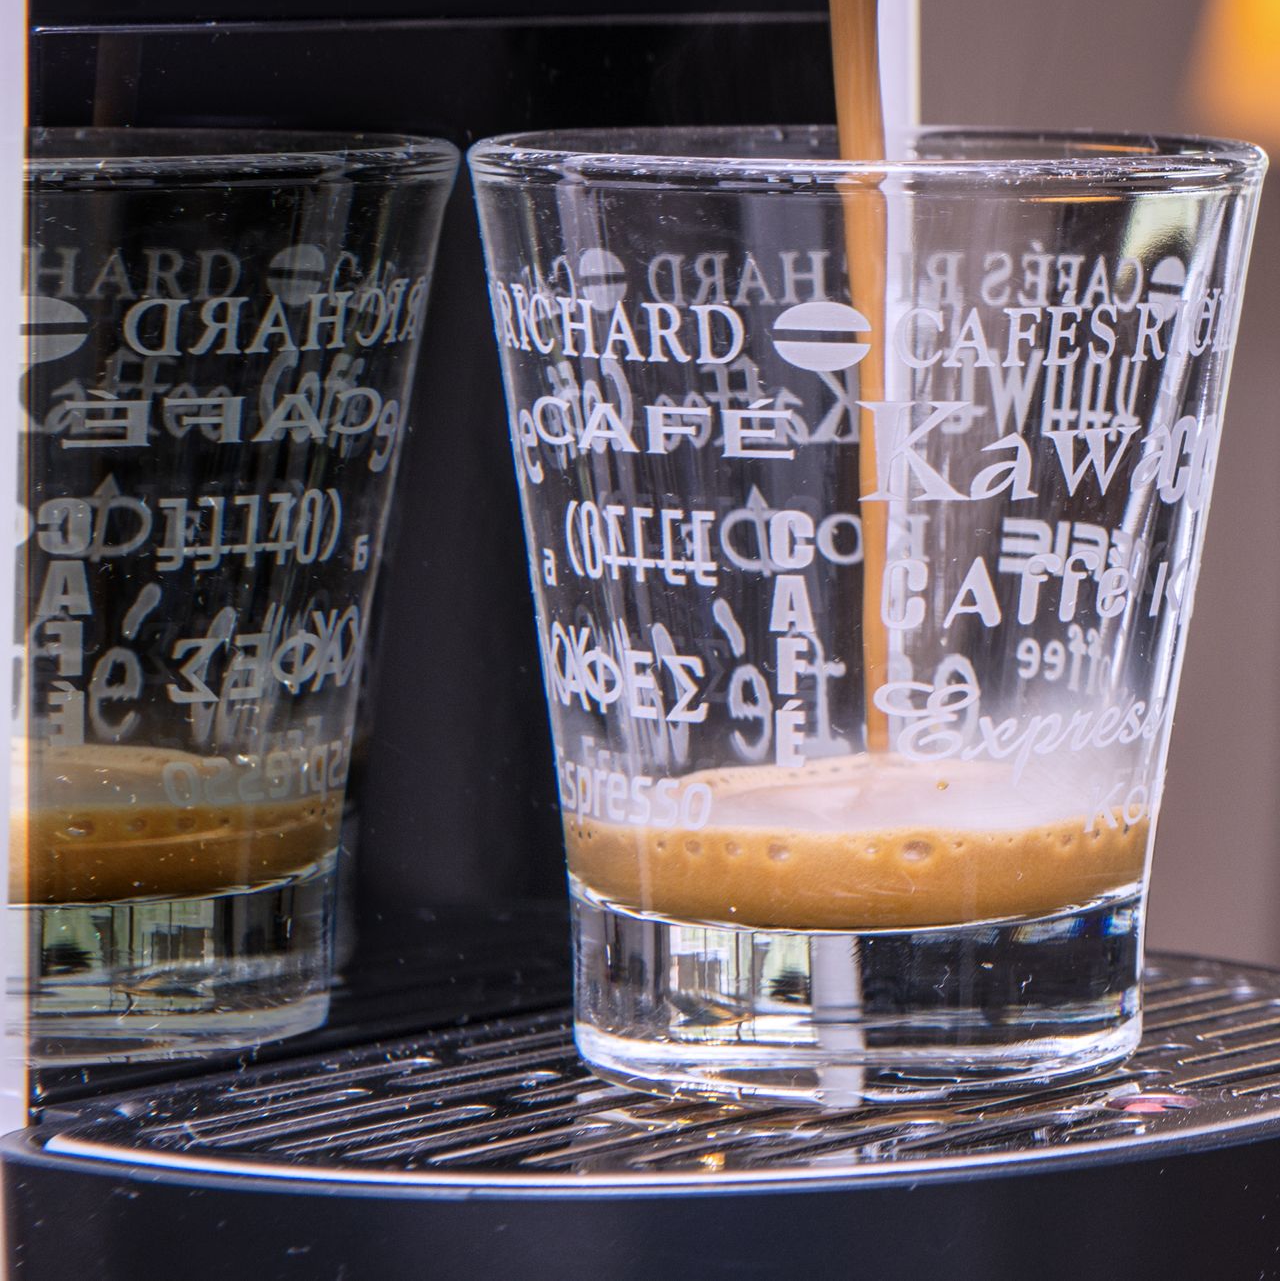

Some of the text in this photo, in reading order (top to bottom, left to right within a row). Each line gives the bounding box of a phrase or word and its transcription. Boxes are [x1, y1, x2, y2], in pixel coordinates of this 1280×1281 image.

[532, 396, 796, 460] CAFÉ
[855, 400, 1176, 502] Kawa
[769, 510, 815, 768] CAFÉ
